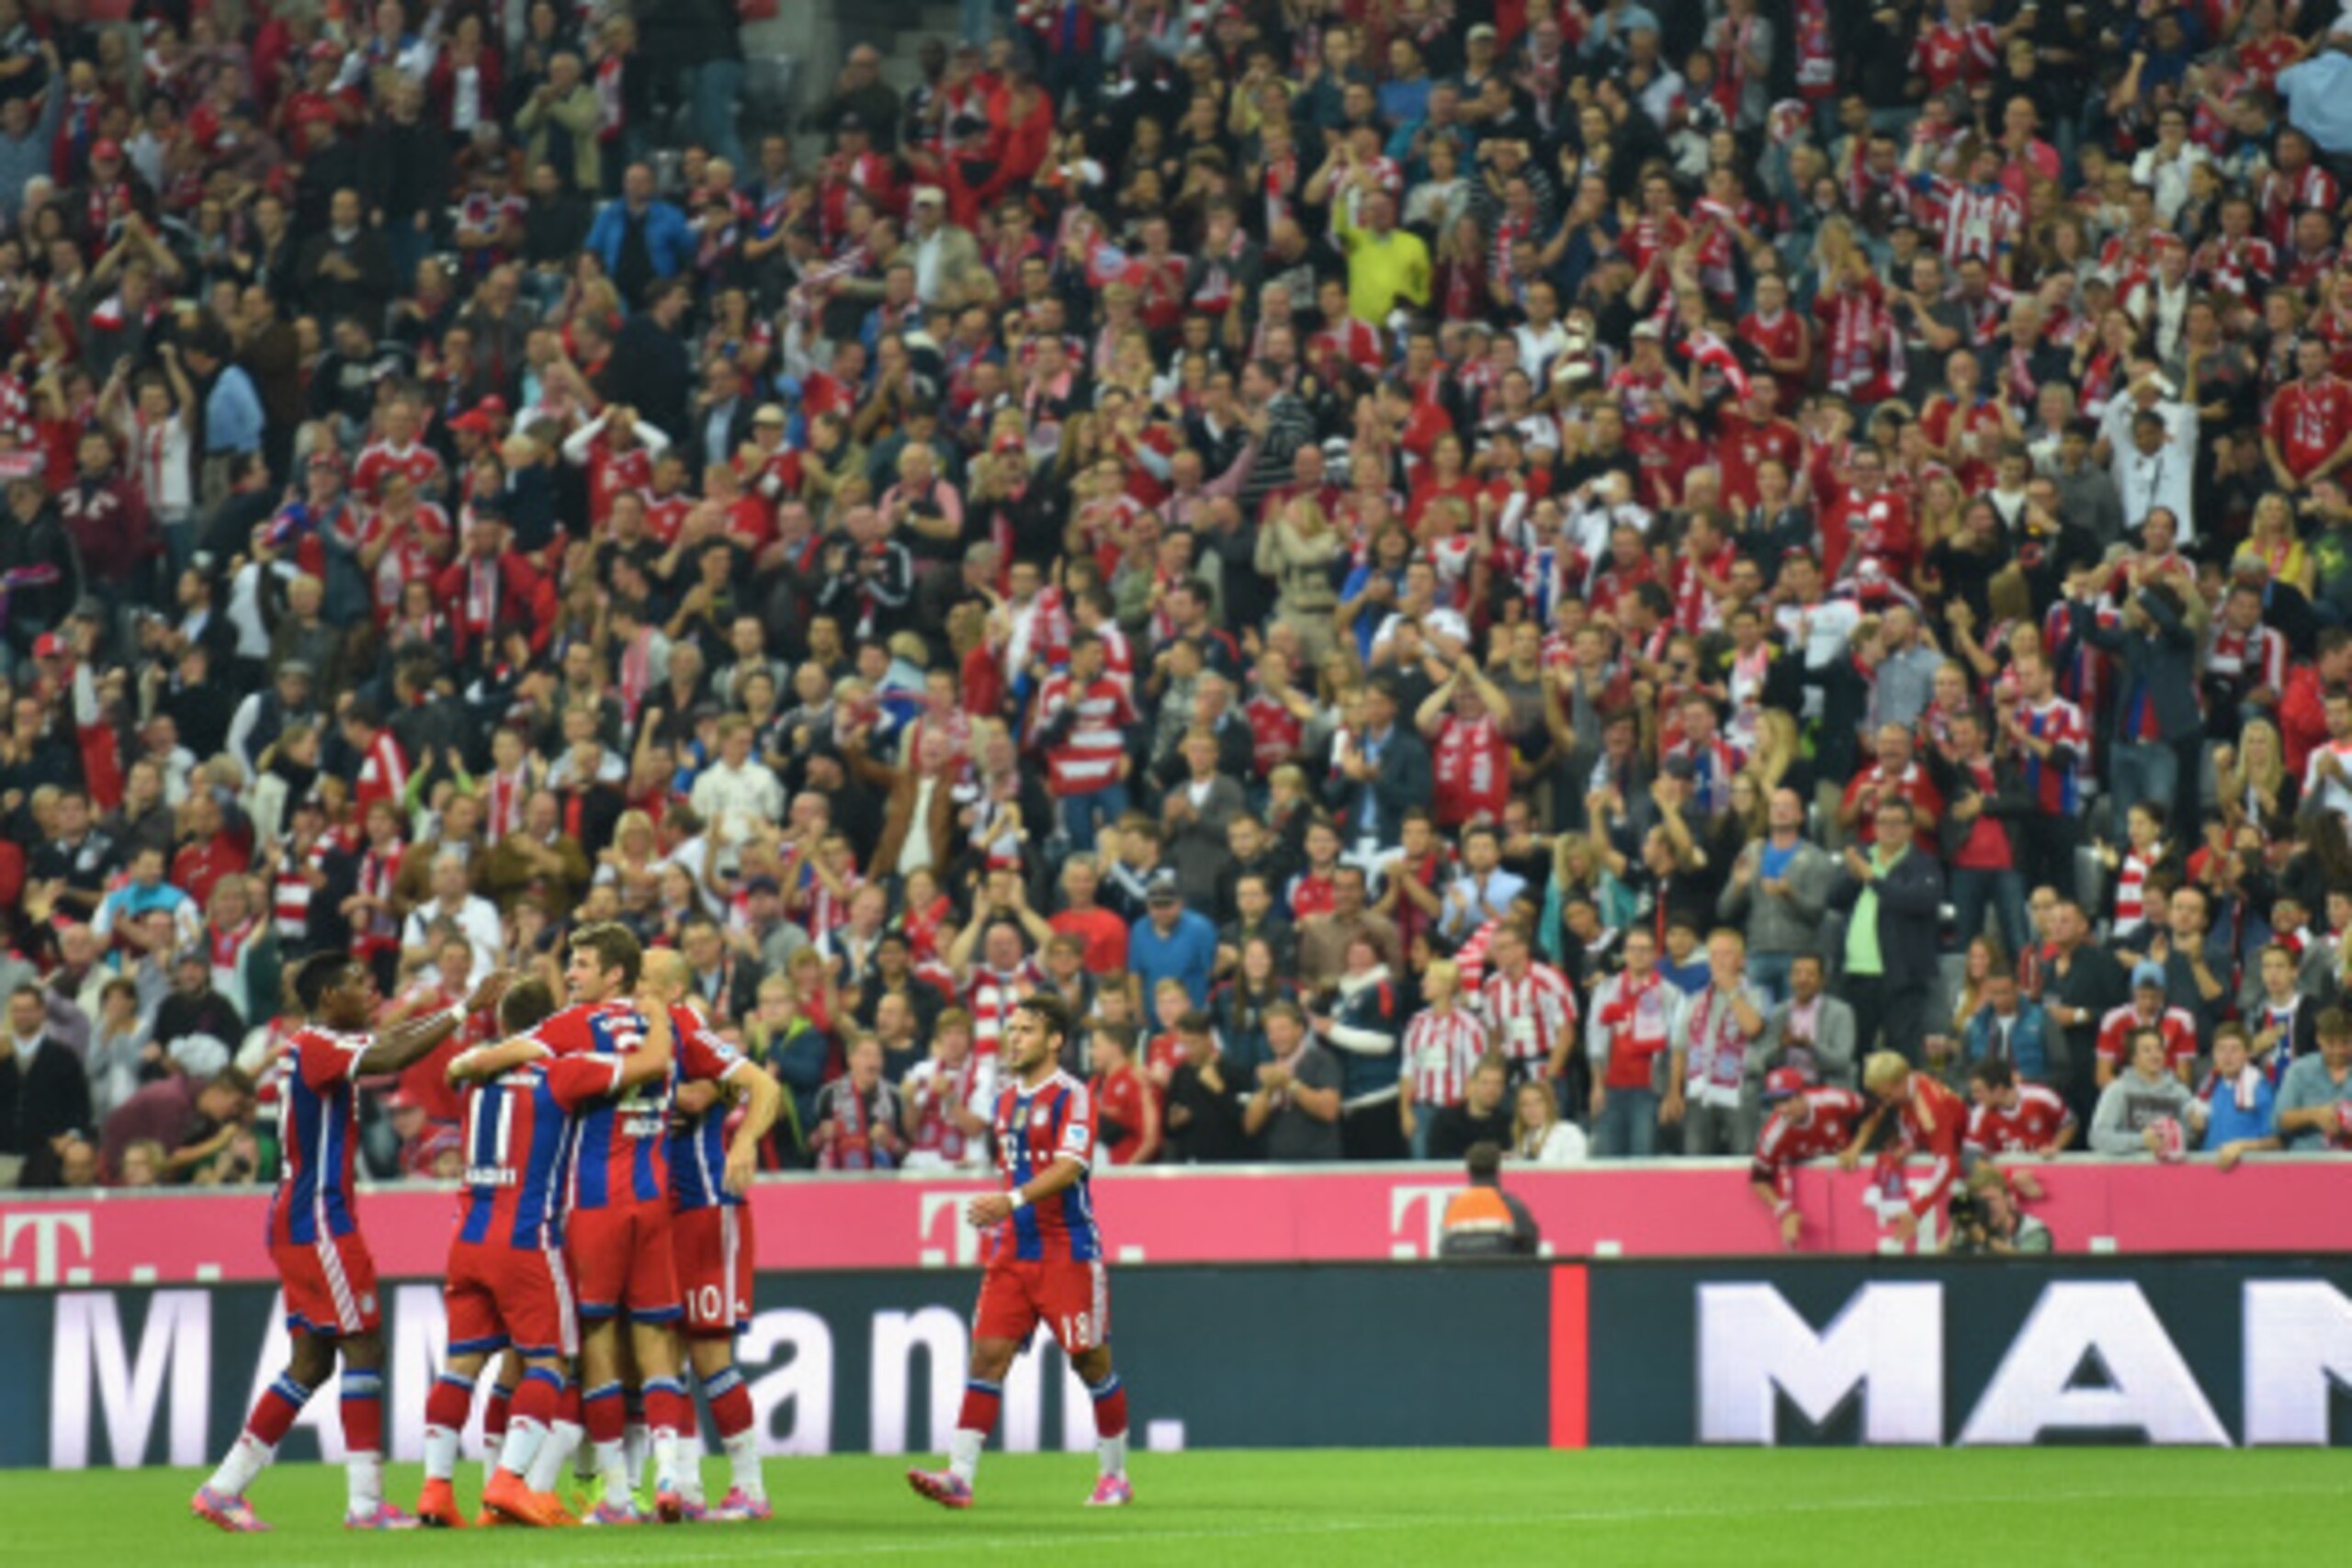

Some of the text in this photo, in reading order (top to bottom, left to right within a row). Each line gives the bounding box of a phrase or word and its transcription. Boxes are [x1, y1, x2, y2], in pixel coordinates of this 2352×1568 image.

[469, 1088, 513, 1168] 11
[685, 1284, 722, 1323] 10
[1061, 1311, 1090, 1348] 18
